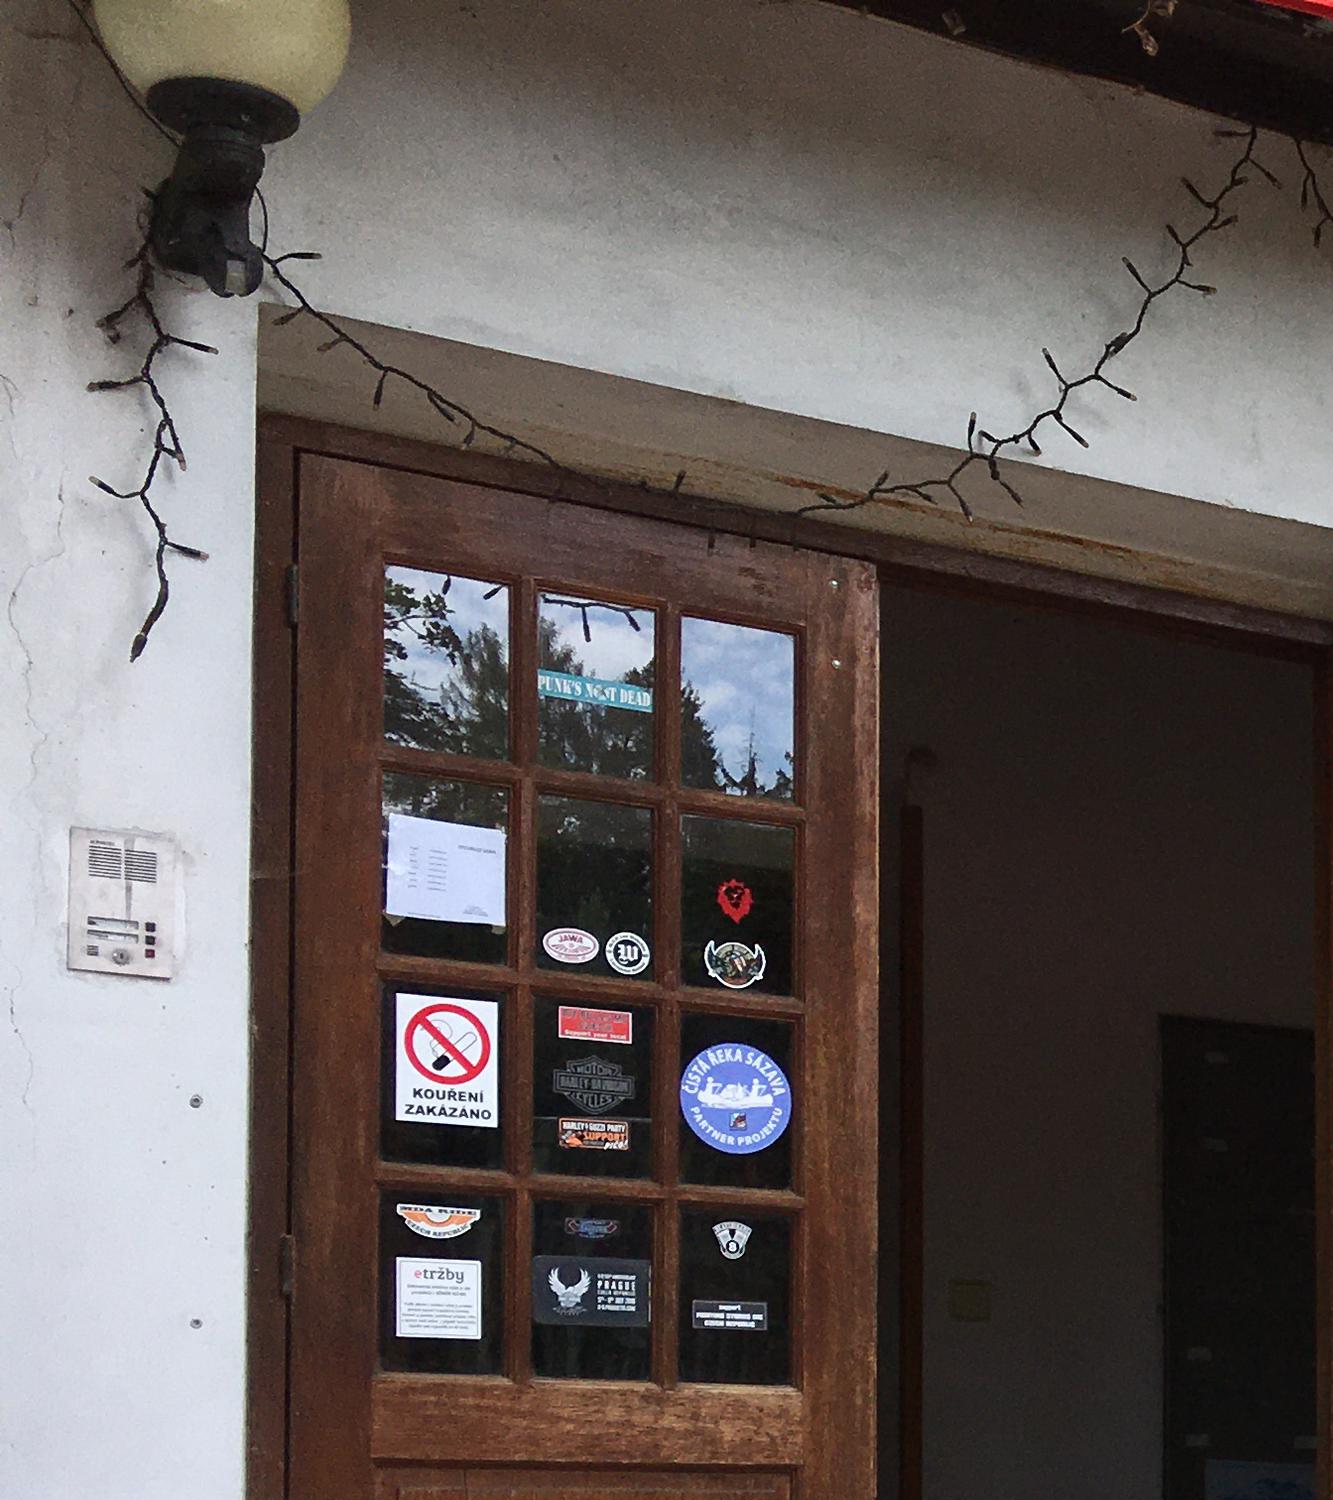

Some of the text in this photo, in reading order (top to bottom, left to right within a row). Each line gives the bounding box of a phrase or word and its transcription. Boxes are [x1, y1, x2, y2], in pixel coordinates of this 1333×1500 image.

[537, 675, 582, 697] PUNK'S
[620, 687, 652, 707] DEAD
[559, 934, 584, 944] JAWA
[682, 1047, 786, 1096] ČISTÁ ŘEKA SÁZAVA
[412, 1087, 484, 1103] KOUŘENÍ
[404, 1103, 491, 1120] ZAKÁZÁNO
[690, 1106, 783, 1146] PARTNER PROJEKTU
[414, 1266, 465, 1284] etržby
[597, 1280, 636, 1291] PRAGUE
